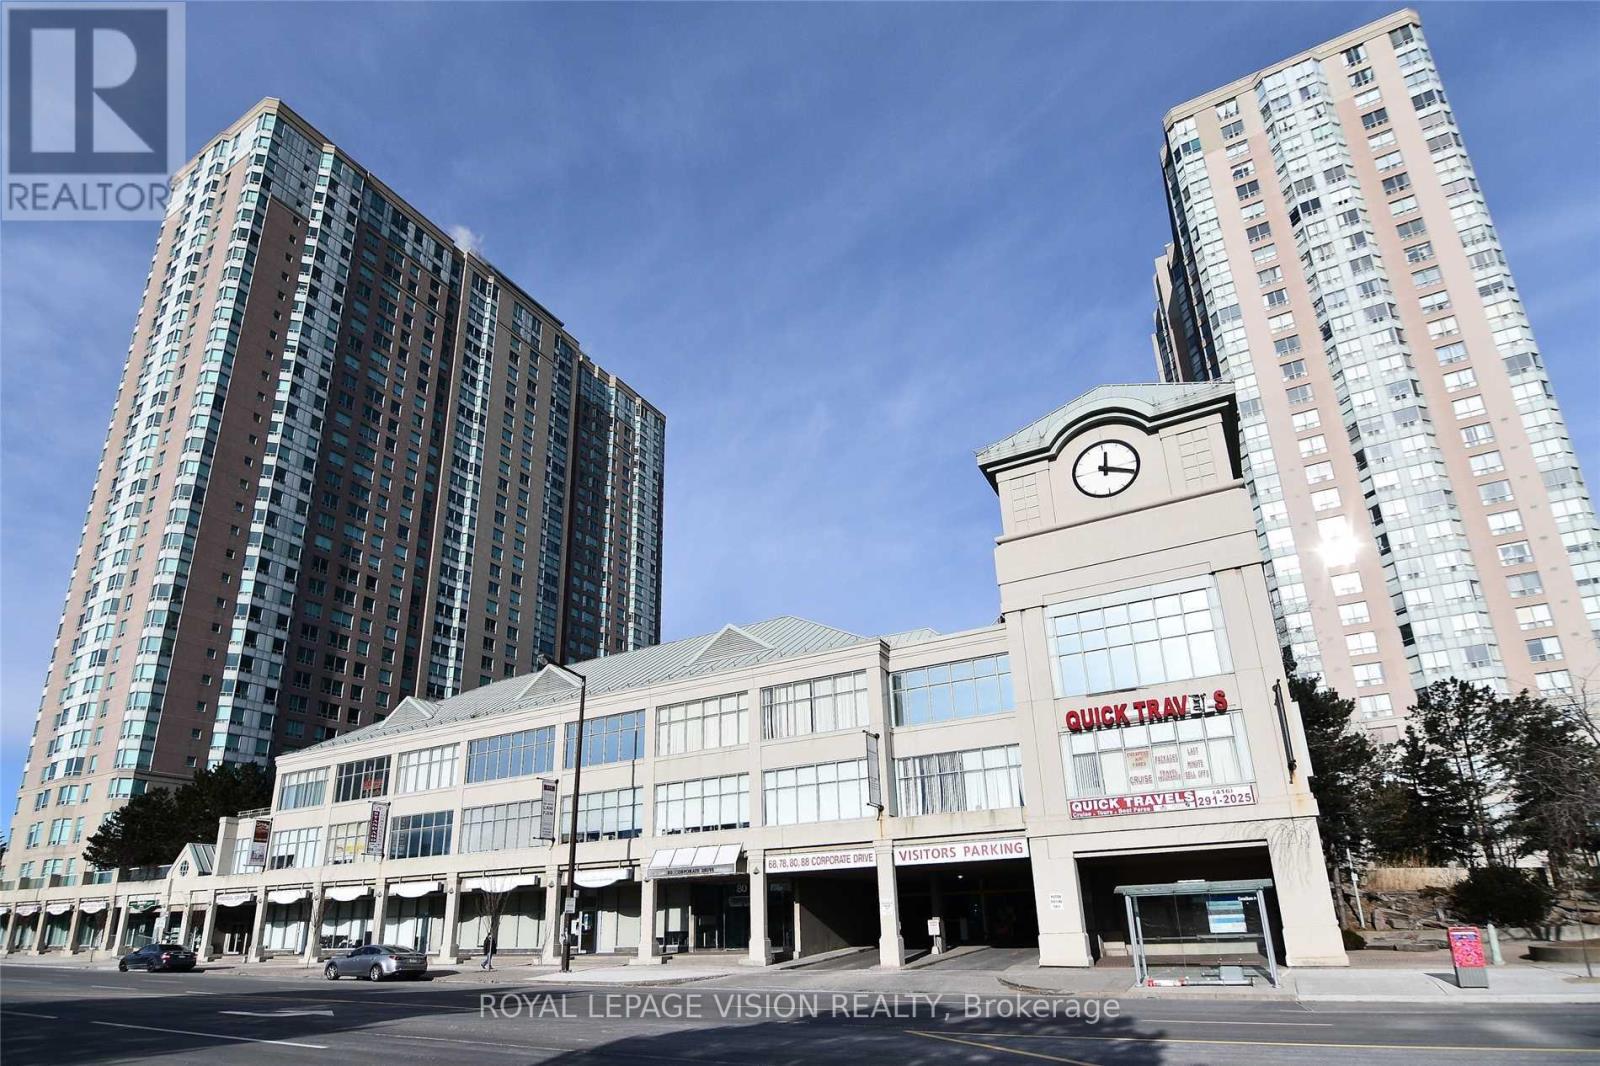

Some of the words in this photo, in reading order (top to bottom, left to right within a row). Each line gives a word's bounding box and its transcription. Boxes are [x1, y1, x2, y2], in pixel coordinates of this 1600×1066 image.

[1065, 703, 1130, 733] QUICK
[1130, 775, 1152, 785] CRUISE
[1071, 799, 1121, 812] QUICK
[1123, 791, 1195, 808] TRAVELS
[1198, 793, 1252, 806] 291-2025
[811, 854, 851, 866] CORPORATE
[853, 853, 874, 863] DRIVE
[899, 846, 957, 862] VISITORS
[963, 842, 1024, 857] PARKING
